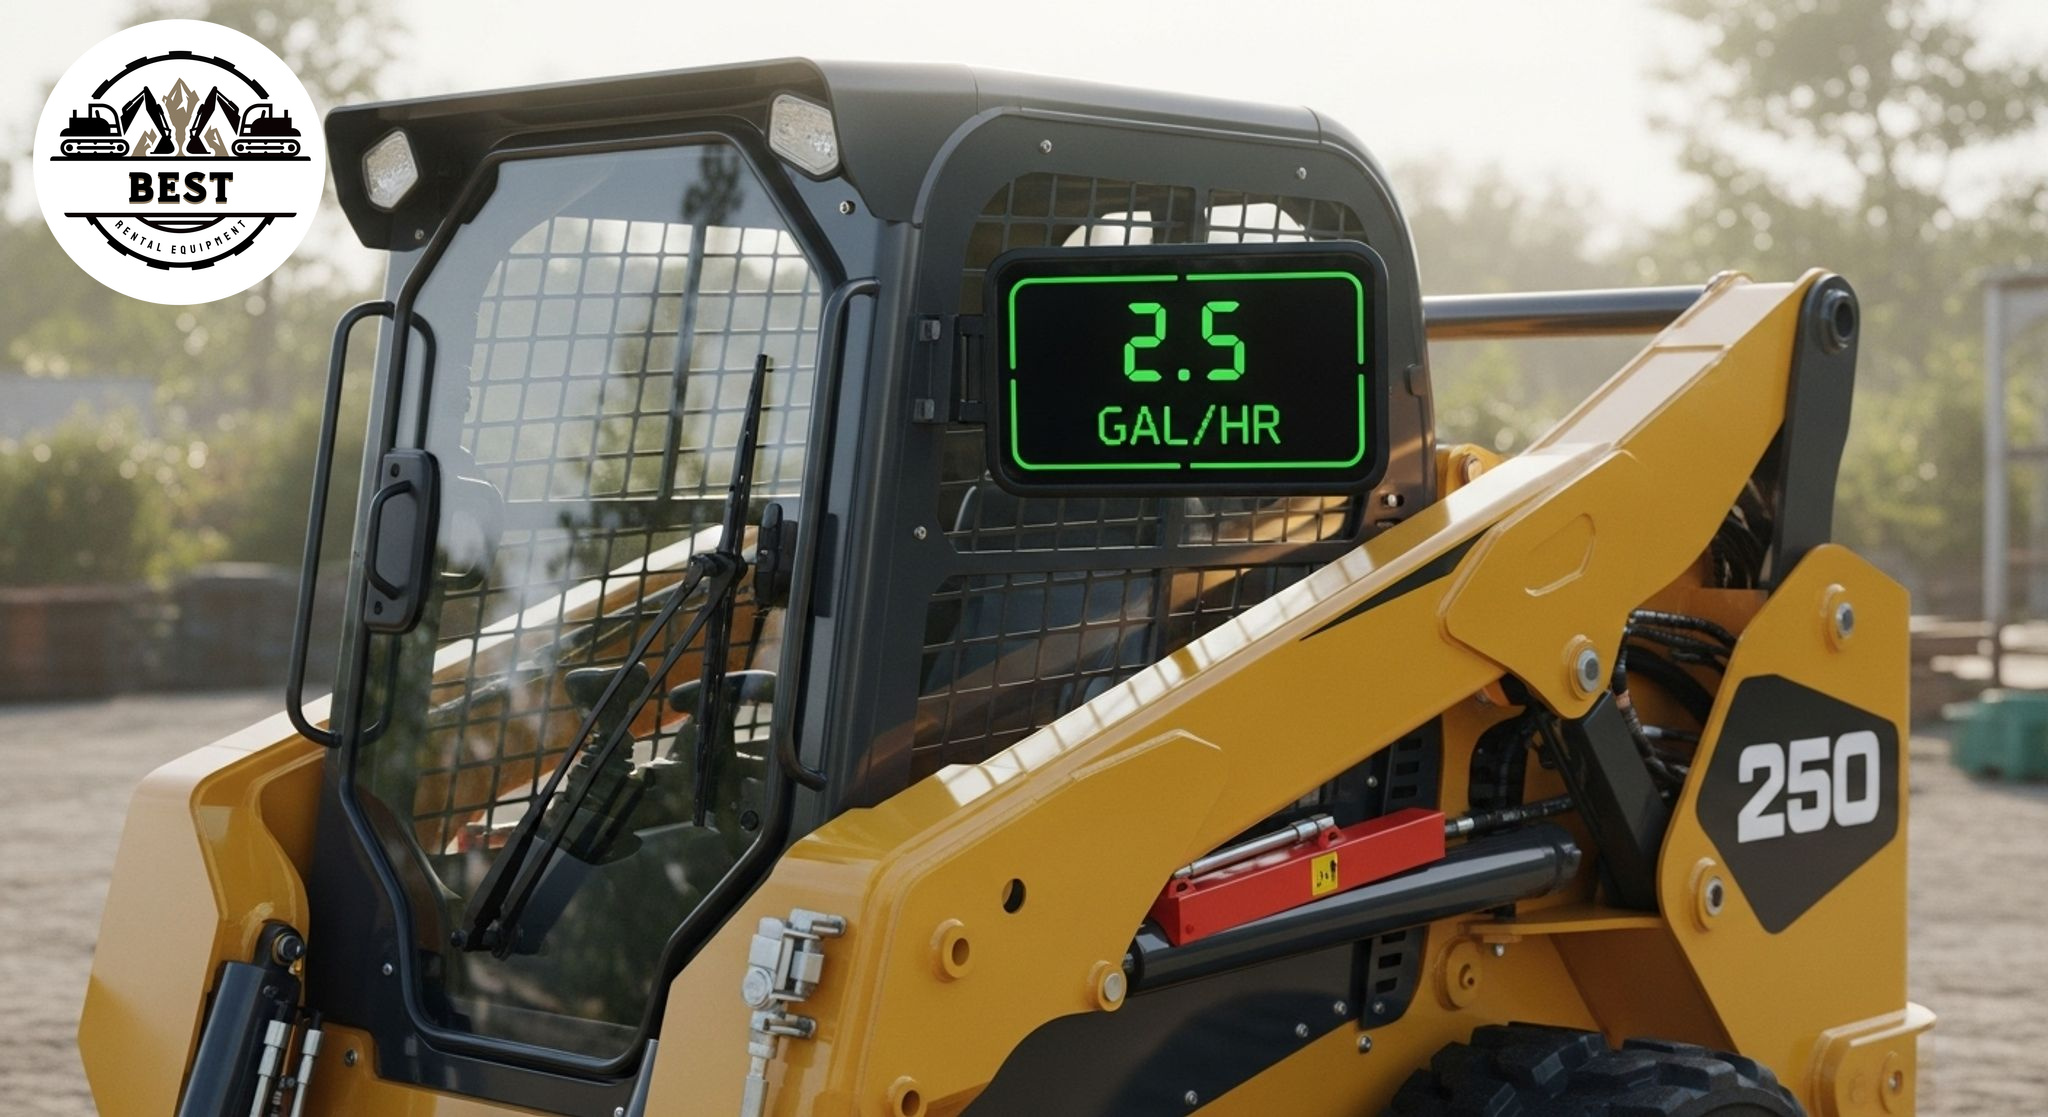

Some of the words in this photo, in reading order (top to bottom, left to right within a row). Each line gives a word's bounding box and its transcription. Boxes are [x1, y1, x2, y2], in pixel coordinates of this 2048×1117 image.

[1124, 301, 1245, 382] 2.5
[1098, 404, 1281, 446] GAL/HR
[1737, 730, 1880, 843] 250
